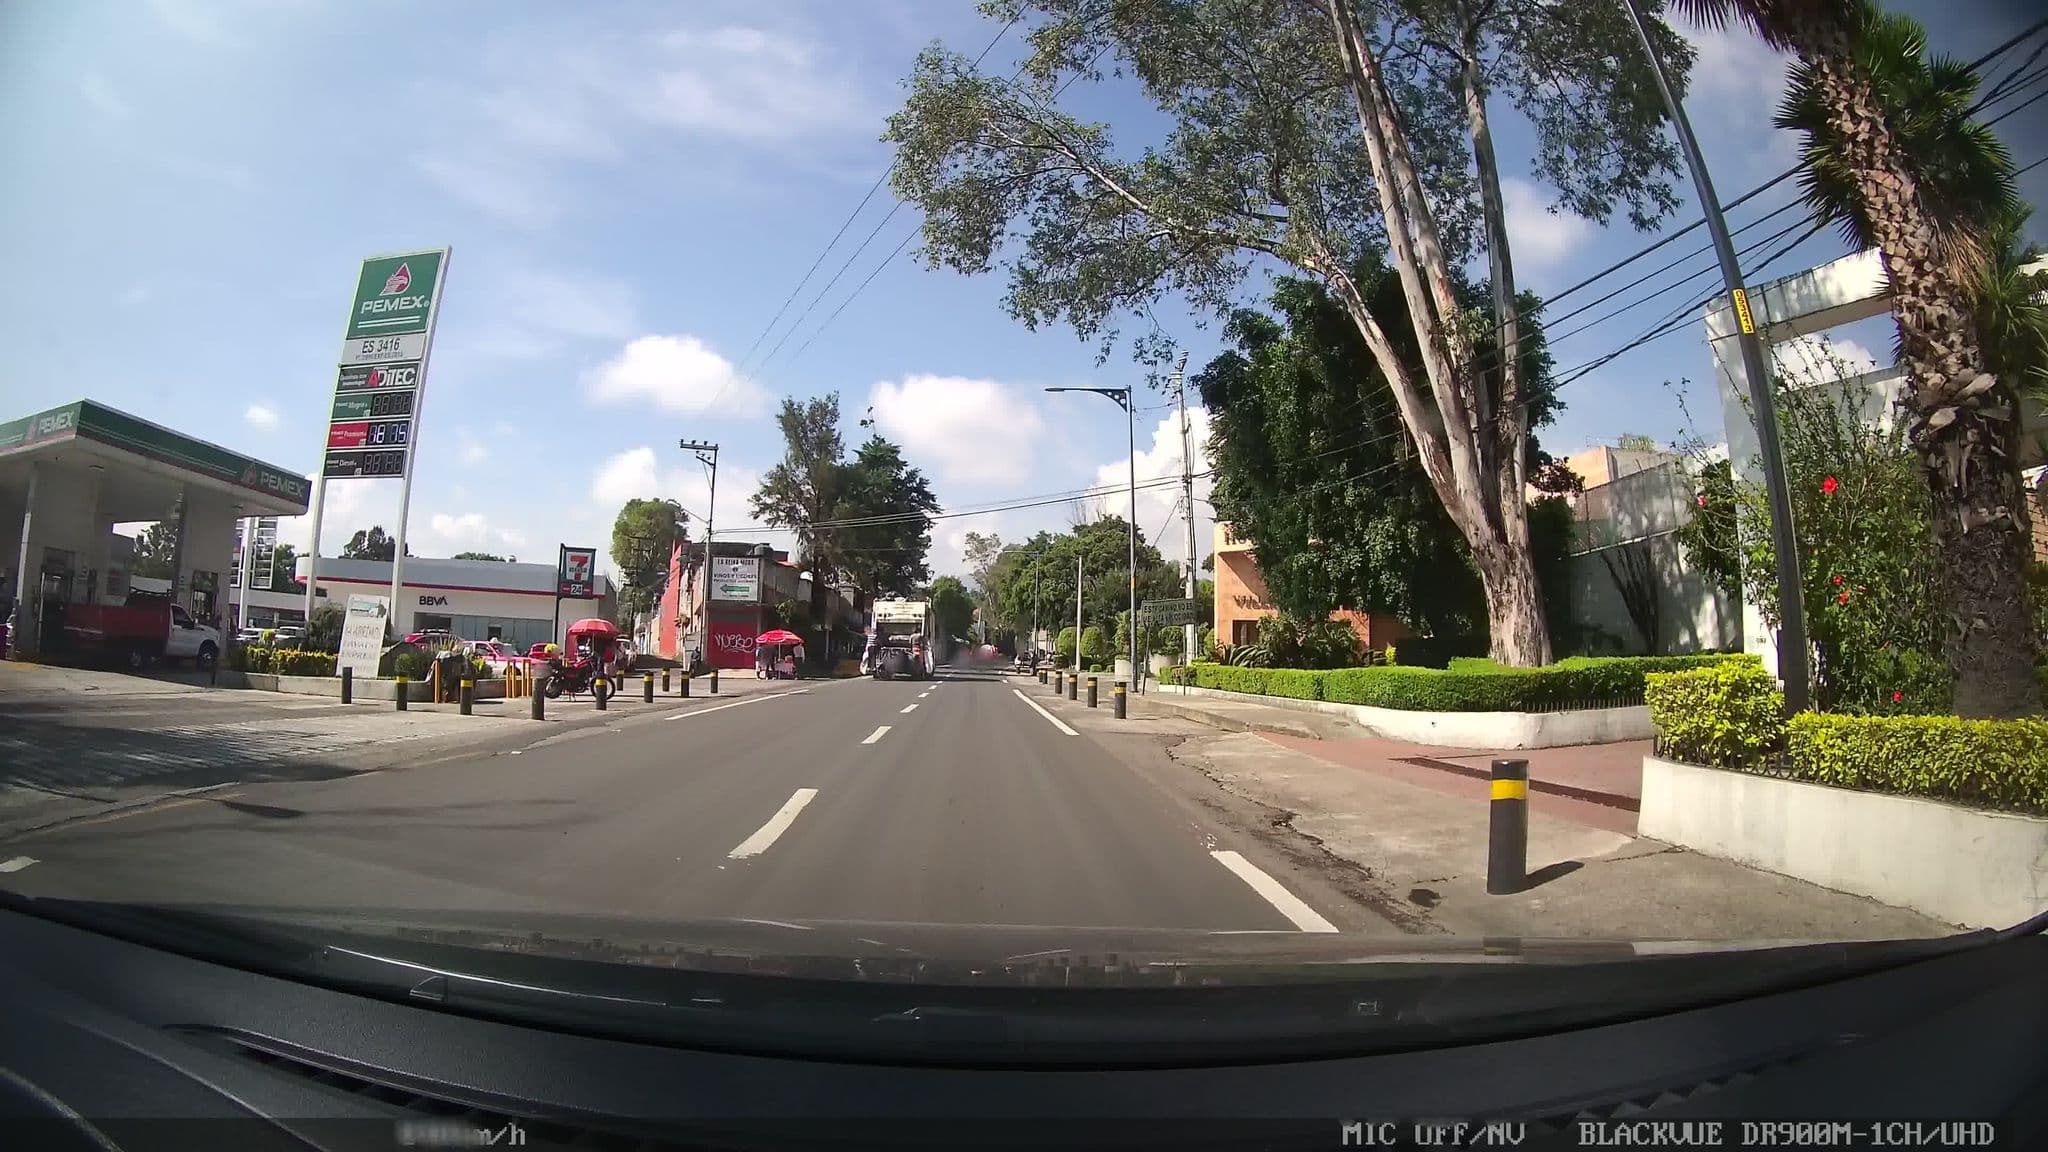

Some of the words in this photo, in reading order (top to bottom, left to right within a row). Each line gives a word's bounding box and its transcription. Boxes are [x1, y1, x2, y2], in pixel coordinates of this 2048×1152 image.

[361, 295, 425, 314] PEMEX
[362, 340, 375, 354] ES
[377, 337, 401, 352] 3416
[39, 410, 75, 433] PEMEX
[260, 471, 304, 498] PEMEX
[570, 555, 588, 581] 7
[572, 585, 582, 594] 24
[419, 595, 448, 606] BBVA
